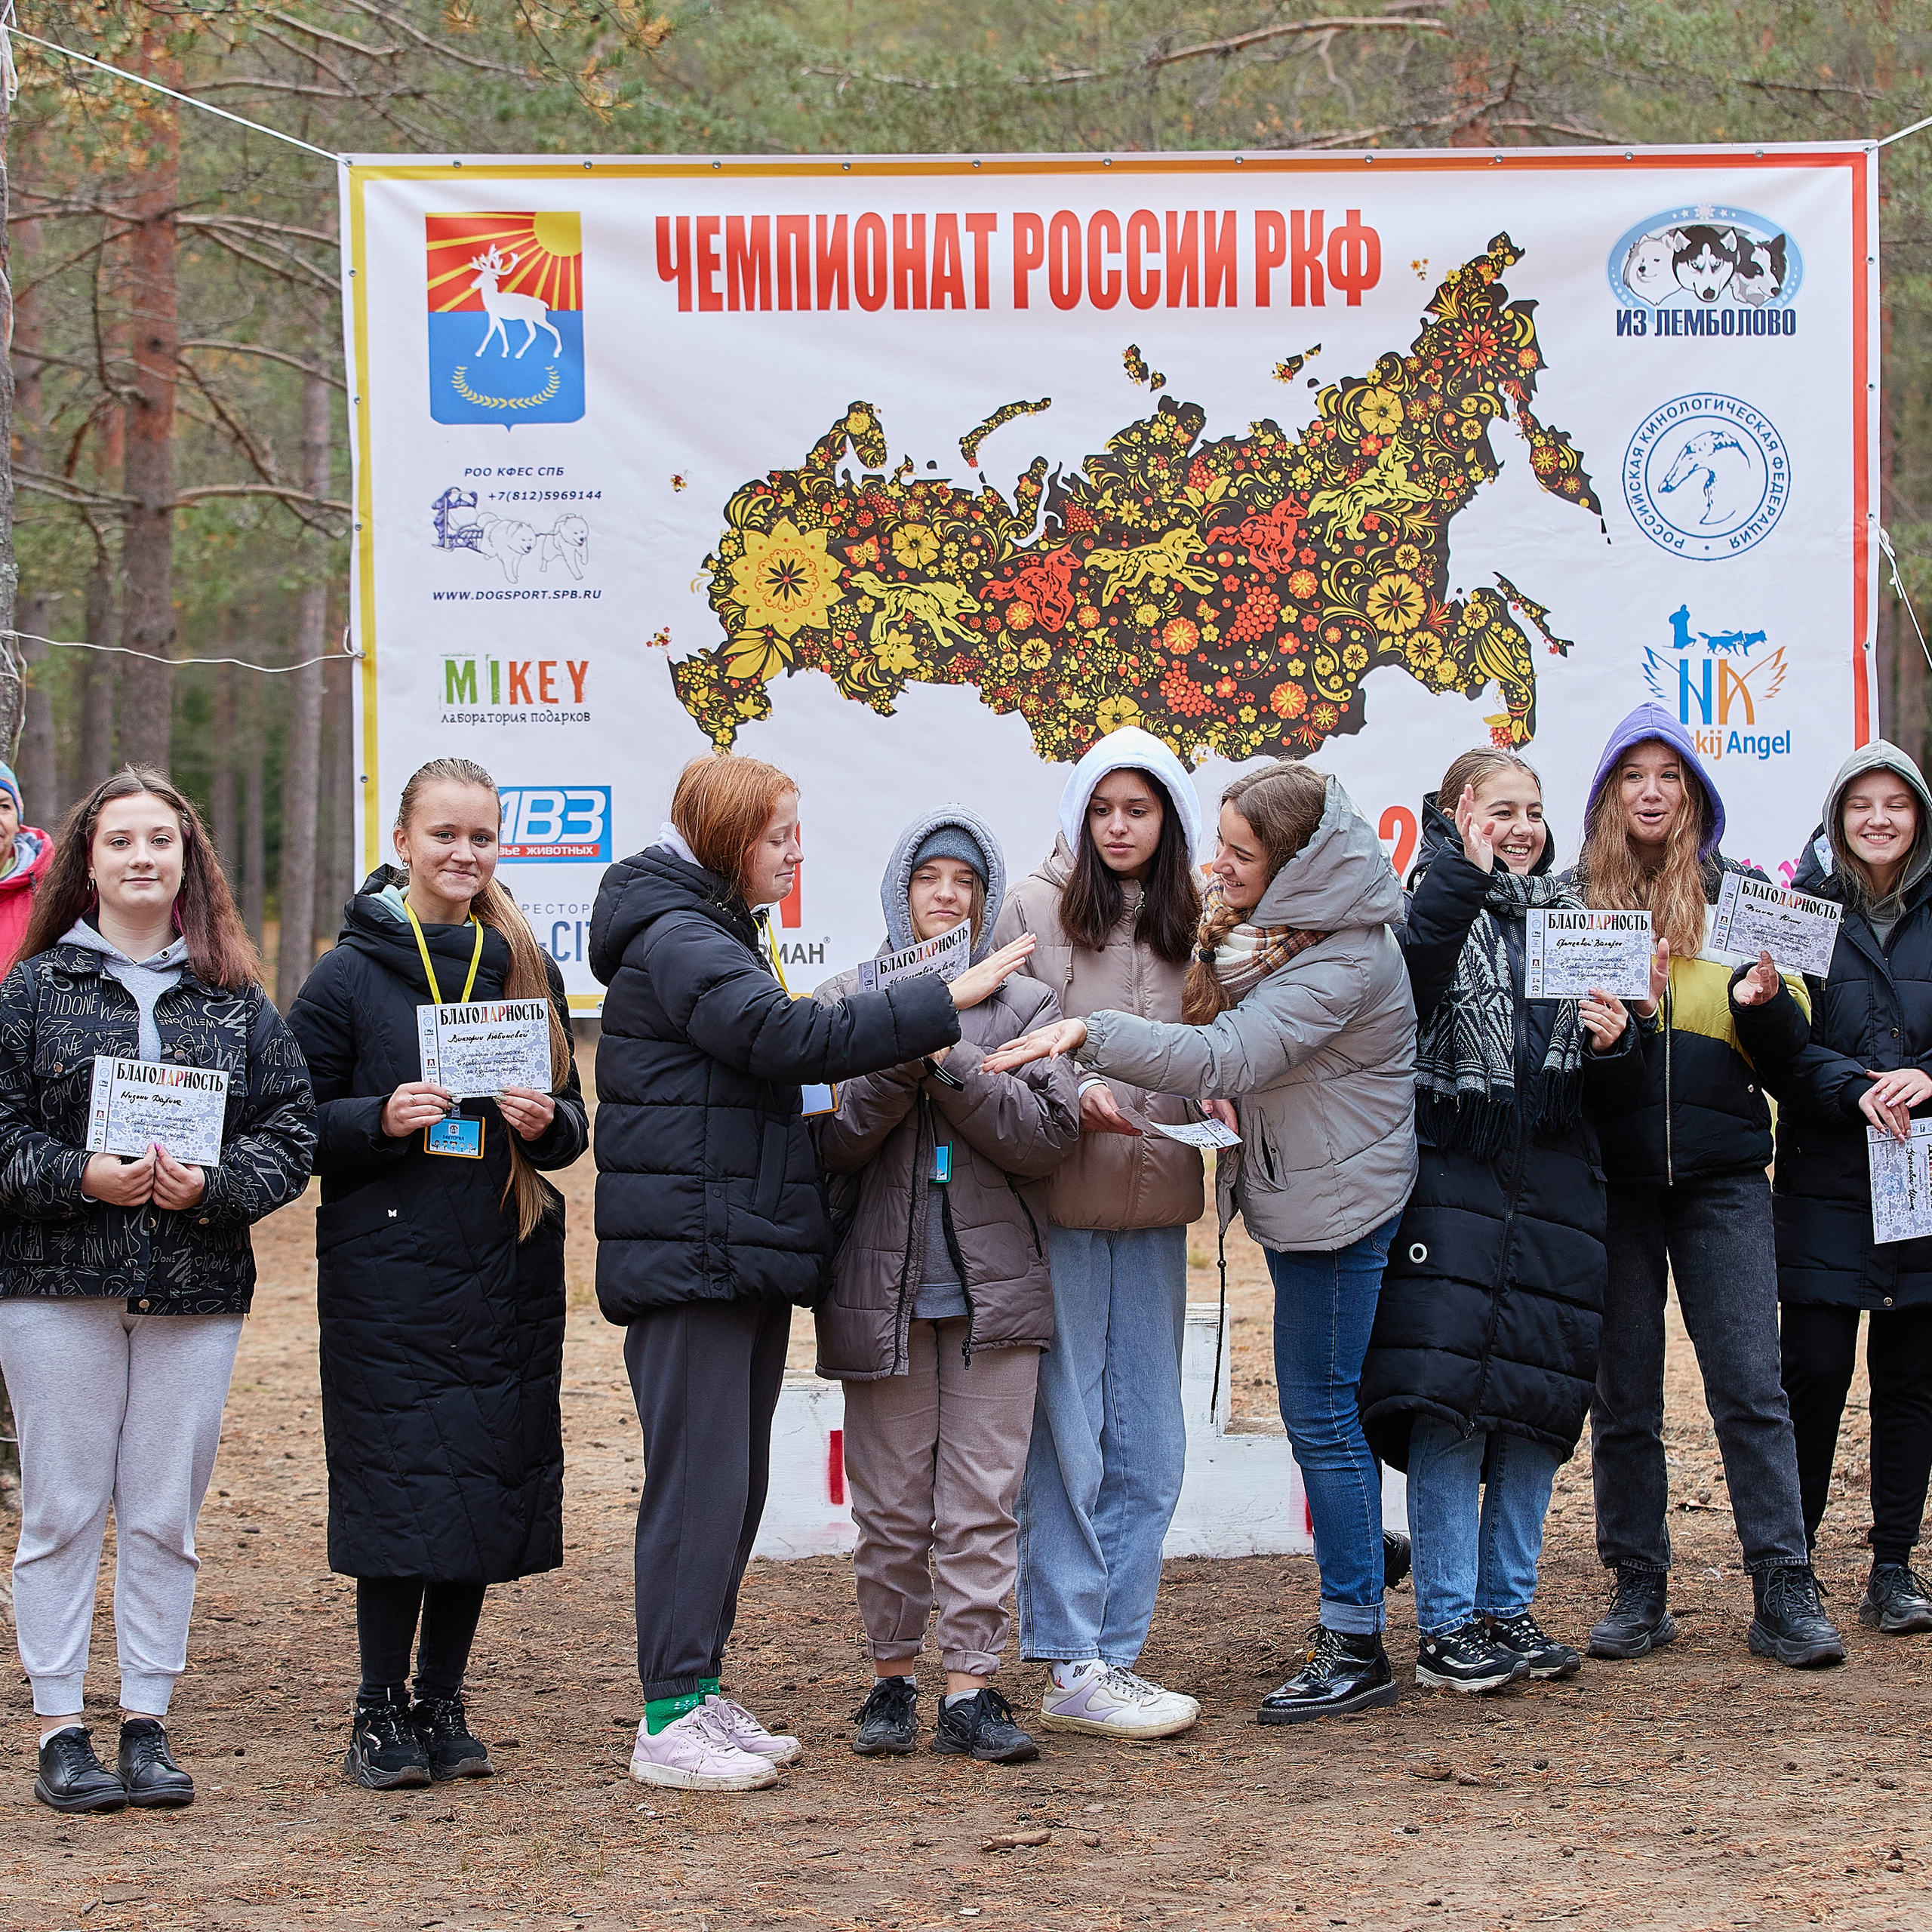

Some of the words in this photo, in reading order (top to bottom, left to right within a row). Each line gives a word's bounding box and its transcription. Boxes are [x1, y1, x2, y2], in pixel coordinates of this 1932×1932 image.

[654, 211, 998, 312] ЧЕМПИОНАТ
[1012, 209, 1237, 310] РОССИИ
[1254, 208, 1382, 308] РКФ
[1616, 309, 1647, 337] ИЗ
[1654, 309, 1796, 337] ЛЕМБОЛОВО
[1639, 398, 1779, 452] КИНОЛОГИЧЕСКАЯ
[464, 467, 492, 477] РОО
[497, 467, 534, 477] КФЕС
[537, 466, 565, 476] СПБ
[488, 491, 602, 503] +7(812)5969144
[1629, 447, 1685, 549] РОССИЙСКАЯ
[1729, 457, 1785, 549] ФЕДЕРАЦИЯ
[432, 590, 602, 601] WWW.DOGSPORT.SPB.RU
[445, 660, 589, 706] MIKEY
[441, 712, 528, 726] лаборатория
[531, 709, 591, 726] подарков
[1726, 730, 1791, 760] Angel
[526, 846, 594, 856] животных
[1741, 880, 1837, 920] БЛАГОДАРНОСТЬ
[1548, 913, 1647, 931] БЛАГОДАРНОСТЬ
[880, 927, 968, 975] БЛАГОДАРНОСТЬ
[440, 1003, 544, 1026] БЛАГОДАРНОСТЬ
[116, 1063, 223, 1092] БЛАГОДАРНОСТЬ
